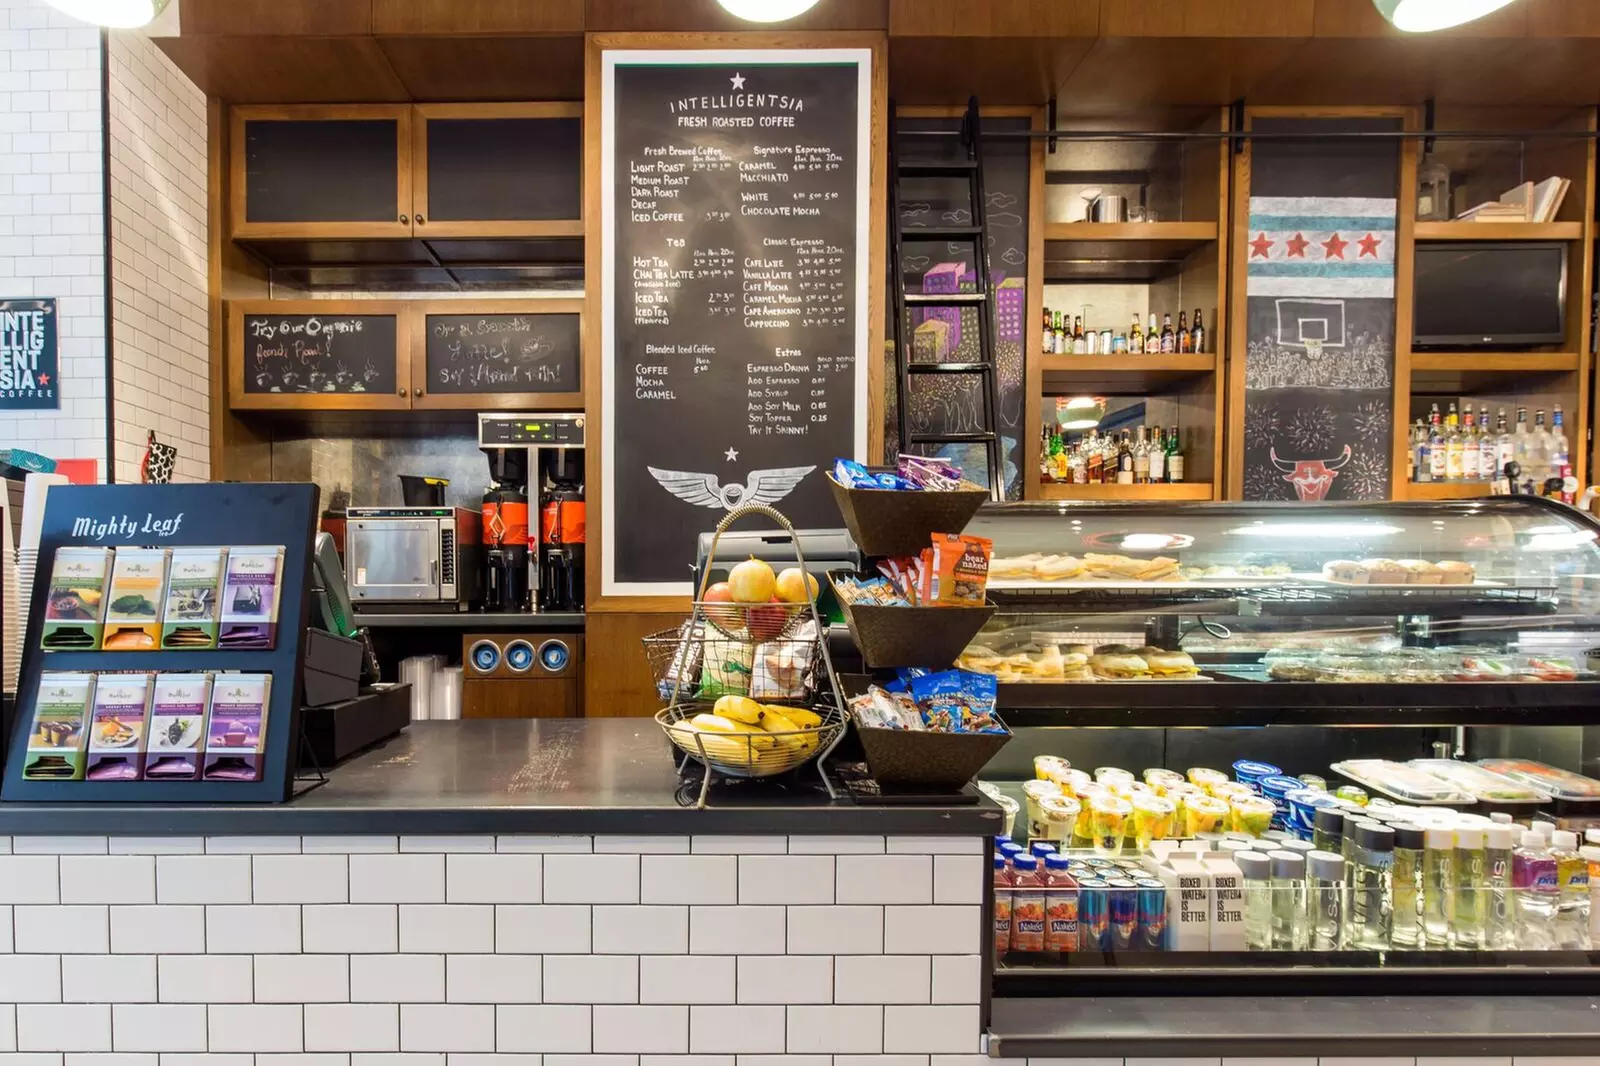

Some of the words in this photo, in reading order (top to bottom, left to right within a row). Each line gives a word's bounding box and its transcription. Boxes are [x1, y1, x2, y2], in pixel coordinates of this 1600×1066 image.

[670, 94, 804, 113] INTELLIGENTSIA
[678, 116, 707, 127] FRESH
[712, 117, 754, 127] ROASTED
[760, 117, 794, 127] COFFEE
[753, 146, 792, 157] Signature
[631, 161, 655, 172] LIGHT
[657, 161, 685, 172] ROAST
[739, 161, 776, 171] CARAMEL
[631, 175, 661, 184] MEDIUM
[664, 174, 690, 185] ROAST
[740, 173, 788, 182] MACCHIATO
[631, 187, 652, 196] DARK
[654, 186, 679, 197] ROAST
[741, 192, 768, 201] WHITE
[631, 199, 656, 209] DECAF
[632, 211, 650, 222] ICED
[652, 210, 684, 222] COFFEE
[741, 205, 790, 216] CHOCOLATE
[793, 207, 820, 216] MOCHA
[633, 256, 651, 267] HOT
[652, 257, 668, 267] TEA
[745, 258, 762, 267] CAFE
[764, 259, 784, 267] LATTE
[653, 268, 668, 279] TEA
[670, 269, 694, 279] LATTE
[743, 269, 770, 279] VANILLA
[772, 270, 792, 279] LATTE
[743, 281, 761, 291] CAFE
[764, 281, 788, 291] MOCHA
[636, 292, 653, 303] ICED
[654, 291, 668, 303] TEA
[744, 293, 776, 303] CARAMEL
[779, 294, 802, 303] MOCHA
[636, 306, 653, 316] ICED
[652, 305, 667, 316] TEA
[744, 305, 761, 315] CAFE
[763, 305, 801, 315] AMERICANO
[0, 311, 44, 331] INTE
[744, 317, 790, 328] CAPPUCCINO
[250, 319, 278, 340] Try
[280, 321, 304, 334] Our
[0, 330, 44, 350] LLIG
[646, 344, 675, 354] Blended
[0, 350, 40, 370] ENT
[636, 364, 668, 374] COFFEE
[0, 369, 36, 390] SIA
[636, 376, 664, 387] MOCHA
[0, 390, 52, 398] COFFEE
[636, 388, 676, 400] CARAMEL
[765, 401, 780, 410] SOY
[782, 401, 801, 411] MILK
[749, 413, 763, 422] SOY
[766, 426, 772, 434] IT
[72, 515, 137, 540] Mighty
[140, 513, 184, 536] Leaf
[965, 553, 984, 562] bear
[963, 561, 987, 570] naked
[1180, 878, 1201, 888] BOXED
[1216, 877, 1236, 888] BOXED
[1182, 889, 1202, 900] WATER
[1217, 889, 1238, 900] WATER
[1181, 901, 1188, 910] IS
[1217, 900, 1224, 910] IS
[1020, 922, 1043, 931] Naked
[1054, 922, 1076, 931] Naked
